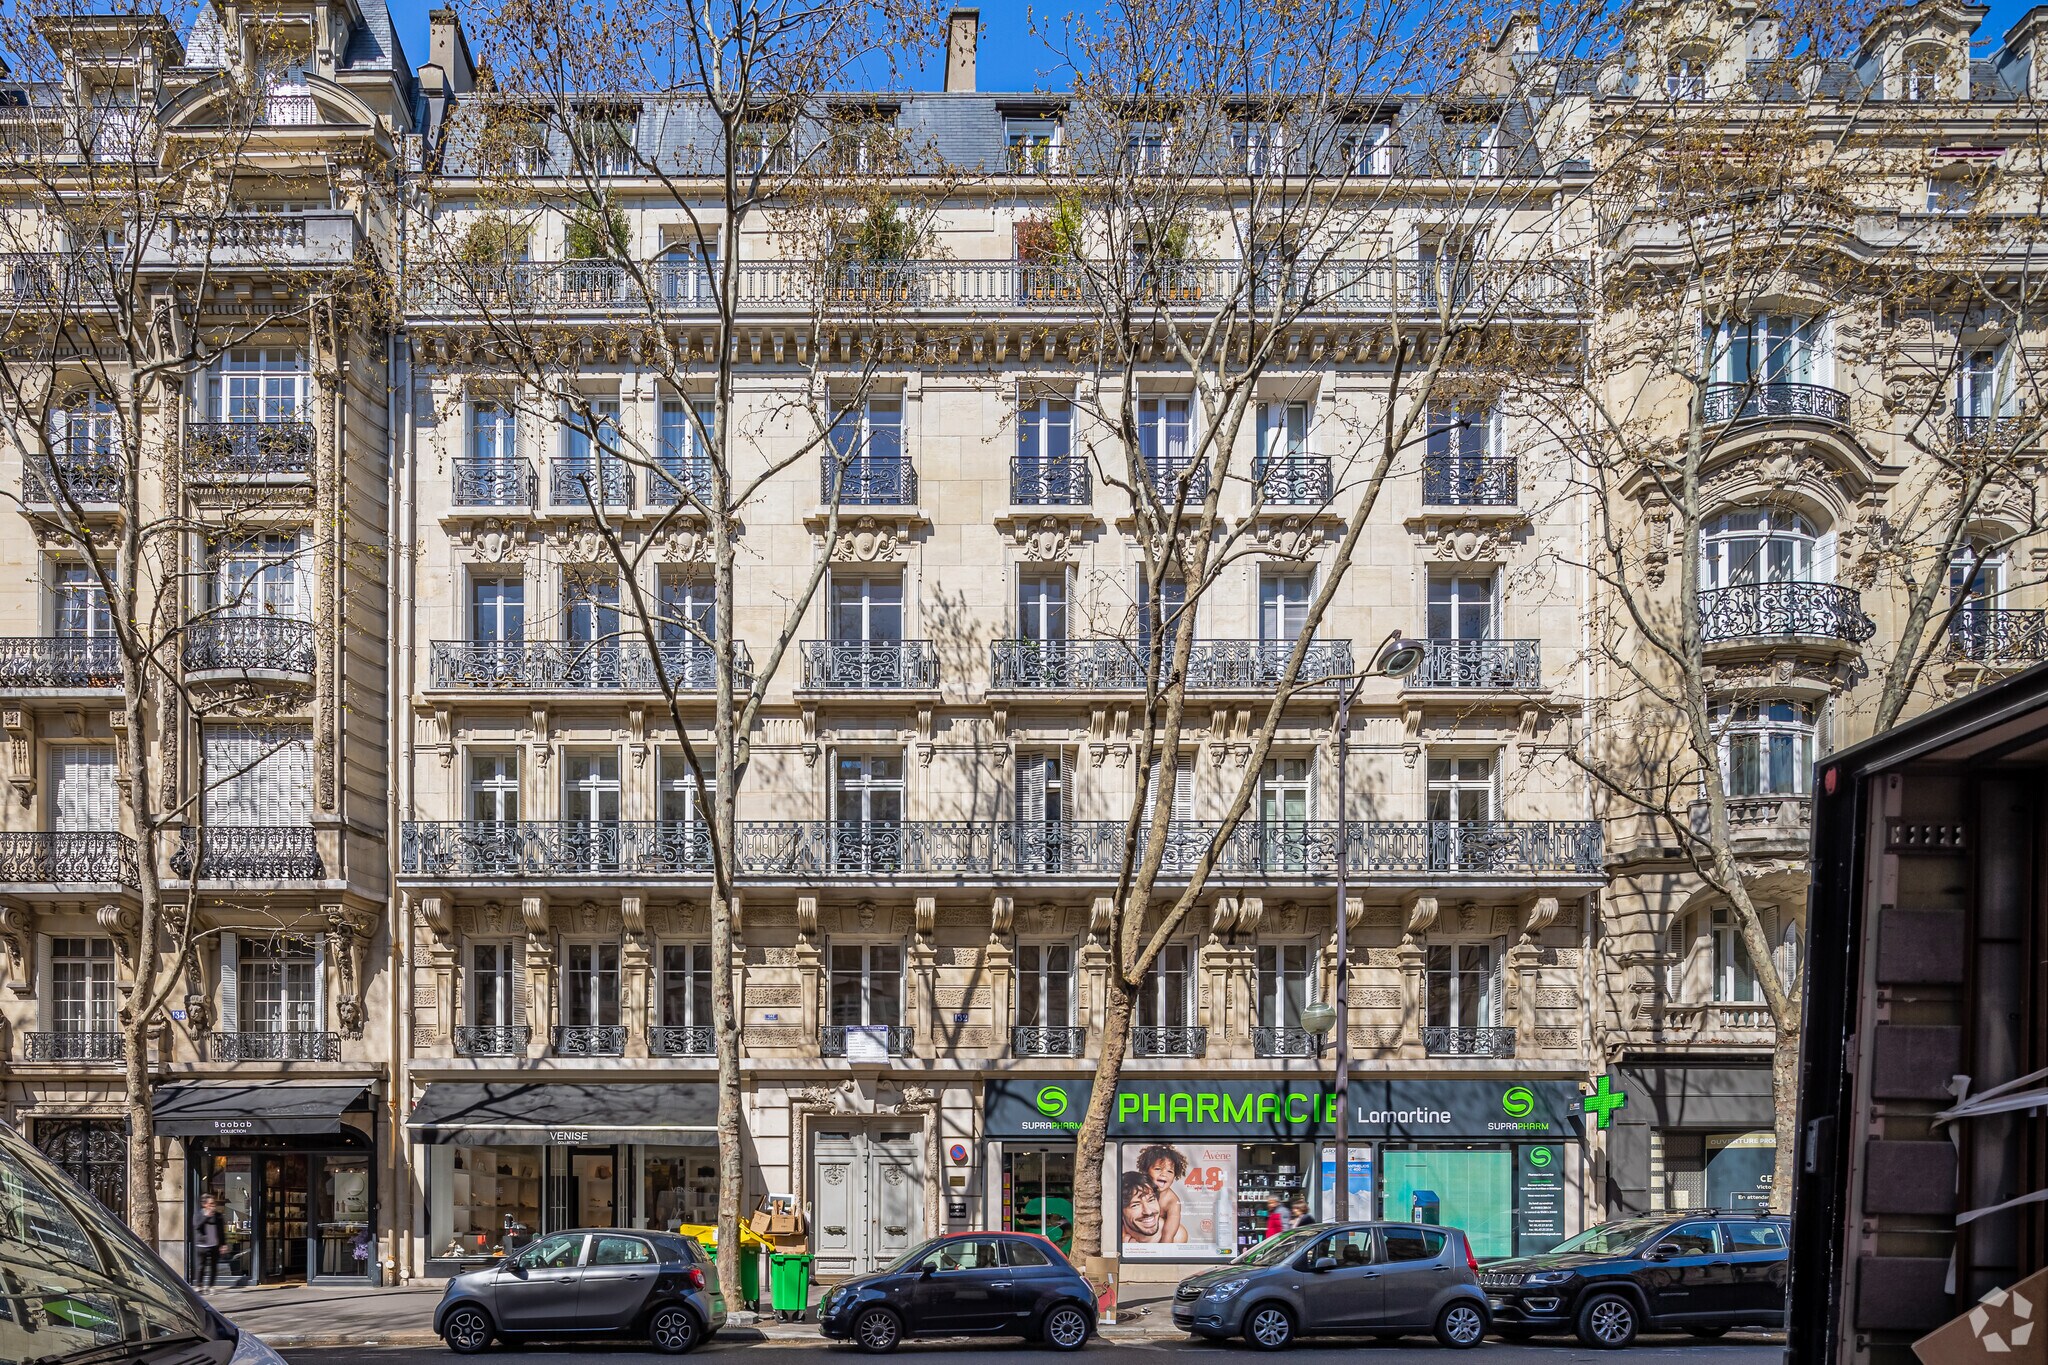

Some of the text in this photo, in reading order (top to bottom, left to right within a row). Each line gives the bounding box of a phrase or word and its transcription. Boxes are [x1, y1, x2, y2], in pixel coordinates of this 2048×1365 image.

[172, 1010, 186, 1020] 134
[954, 1013, 968, 1022] 132
[1357, 1107, 1451, 1124] Lamartine
[1021, 1121, 1083, 1130] SUPRAPHARM
[1487, 1122, 1549, 1131] SUPRAPHARM
[549, 1131, 589, 1141] VENISE
